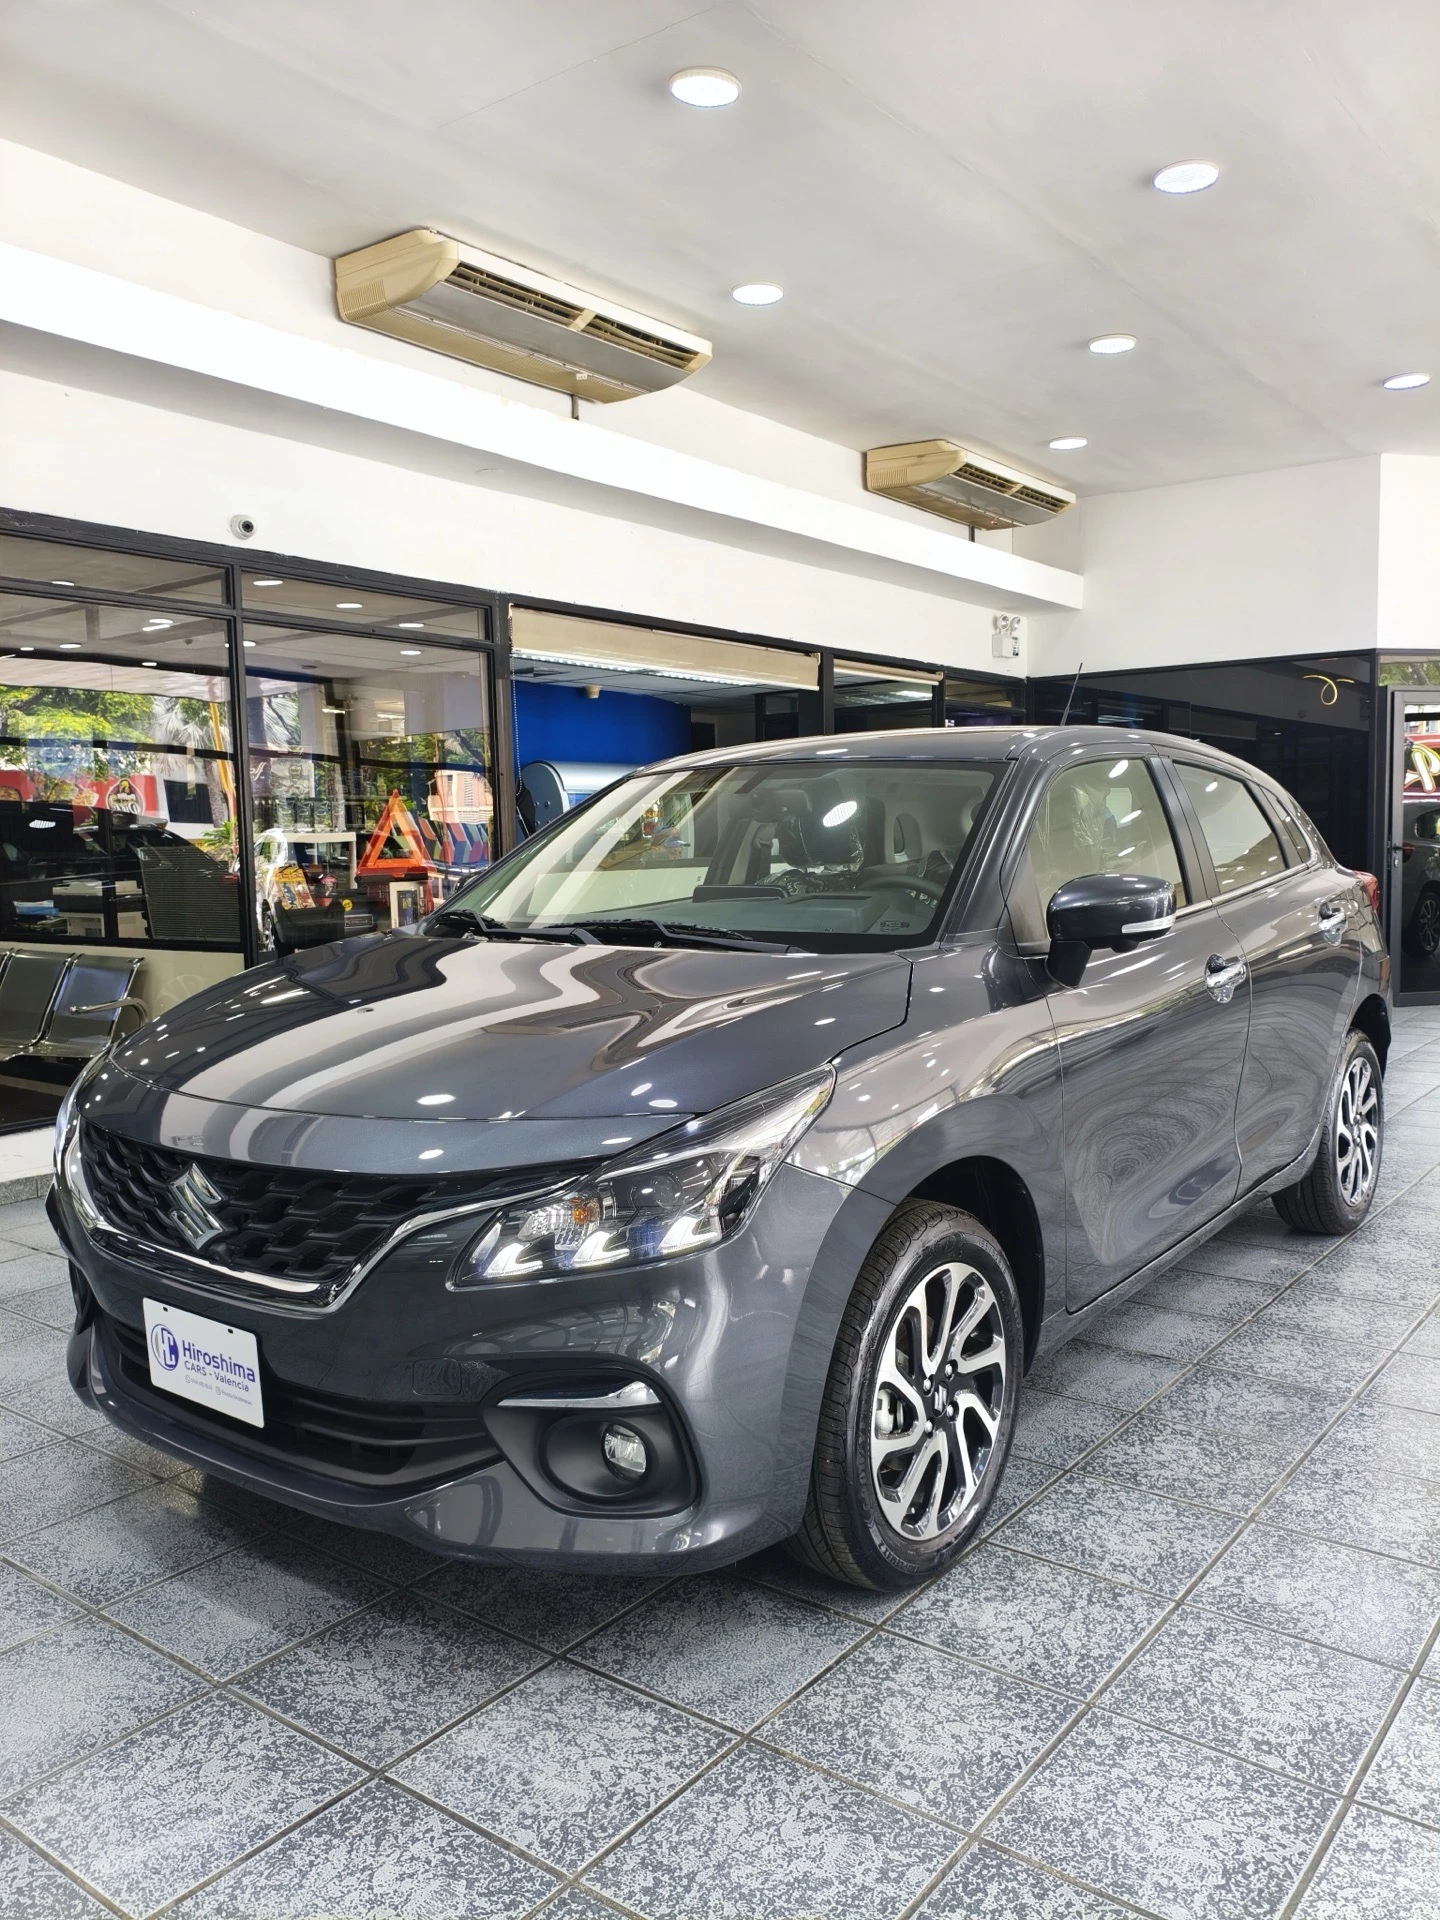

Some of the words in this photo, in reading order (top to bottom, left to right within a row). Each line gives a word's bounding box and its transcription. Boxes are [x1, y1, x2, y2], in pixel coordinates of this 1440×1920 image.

[182, 1339, 256, 1383] Hiroshima
[184, 1360, 207, 1377] CARS
[214, 1371, 250, 1393] Valencia
